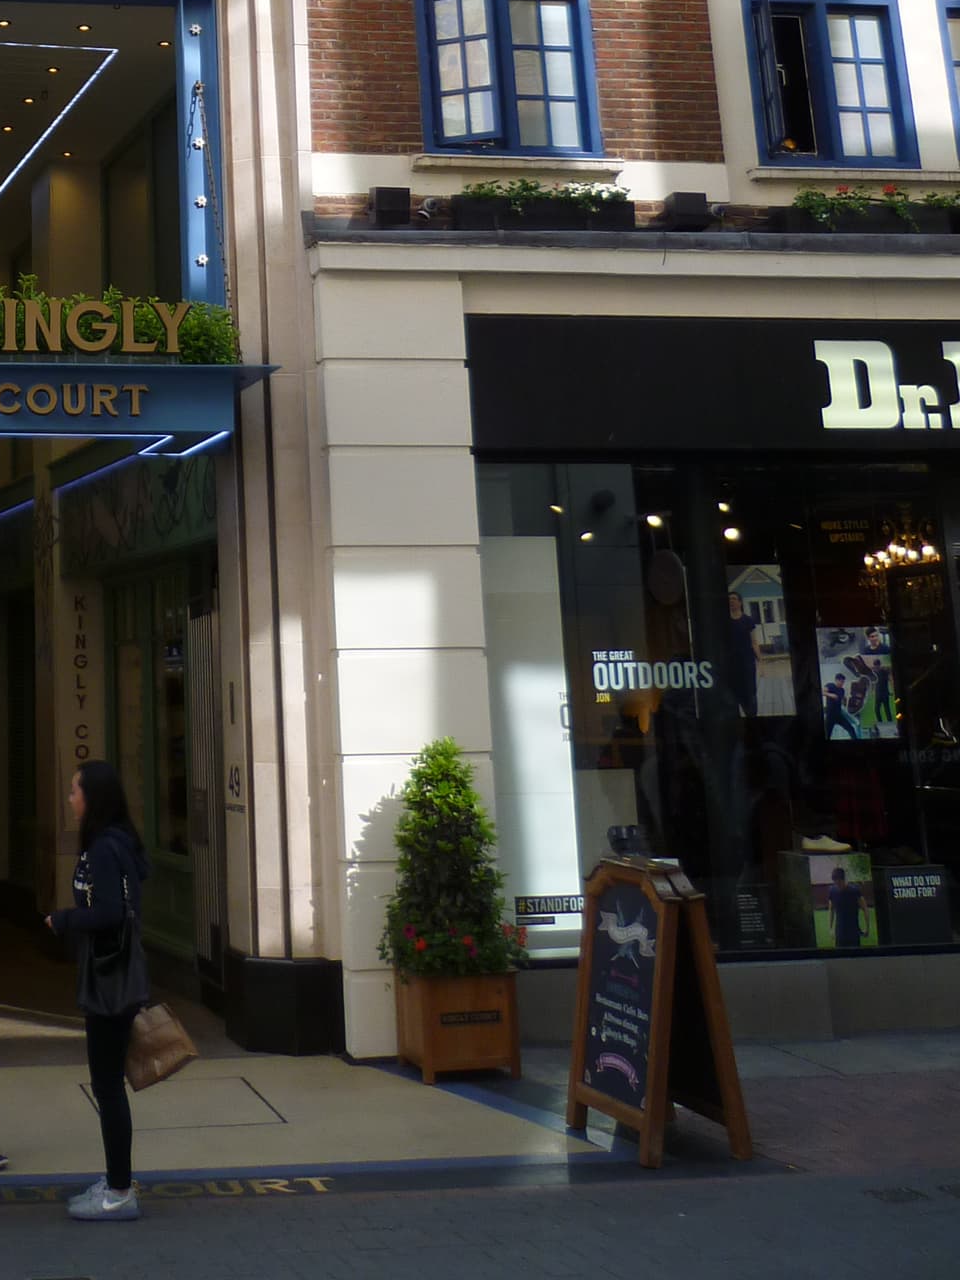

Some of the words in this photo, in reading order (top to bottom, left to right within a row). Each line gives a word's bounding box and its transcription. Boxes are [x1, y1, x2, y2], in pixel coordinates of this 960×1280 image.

[72, 595, 89, 711] KINGLY
[592, 650, 608, 661] THE
[609, 650, 634, 661] GREAT
[592, 661, 714, 691] OUTDOORS
[229, 765, 241, 798] 49
[891, 875, 912, 888] WHAT
[913, 875, 925, 887] DO
[925, 874, 941, 886] YOU
[893, 887, 917, 899] STAND
[132, 1175, 335, 1198] OURT
